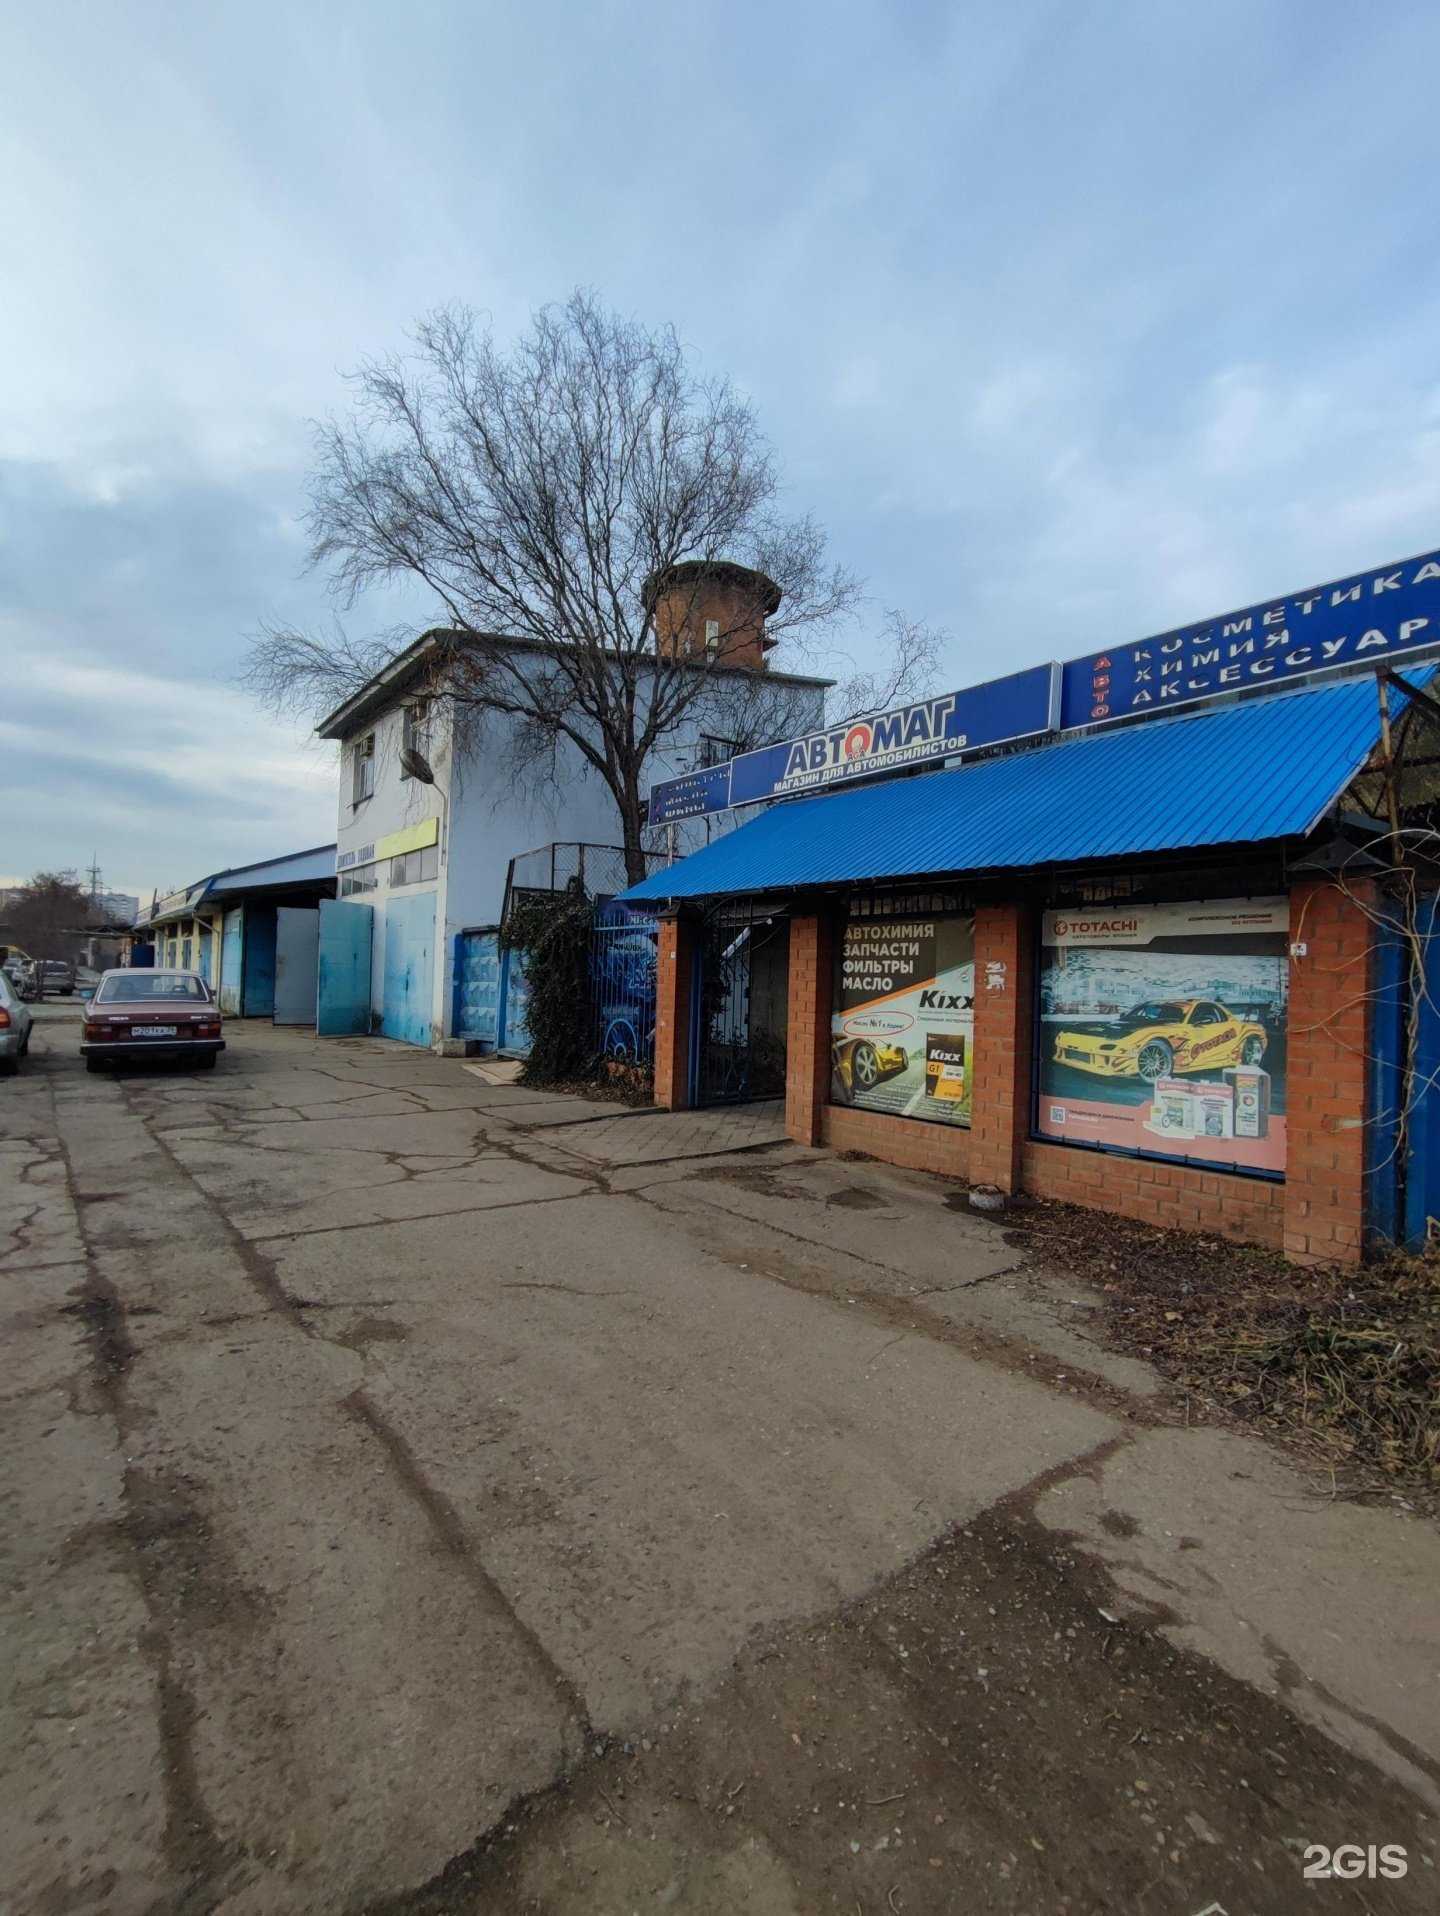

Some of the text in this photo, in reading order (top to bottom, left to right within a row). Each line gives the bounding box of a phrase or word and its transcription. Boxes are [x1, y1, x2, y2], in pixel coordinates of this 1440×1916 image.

[1134, 628, 1291, 683] ХИМИЯ
[1091, 655, 1112, 719] АВТО
[784, 695, 956, 780] АВТОМАГ
[774, 734, 968, 793] МАГАЗИН ДЛЯ АВТОМОБИЛИСТОВ
[844, 924, 935, 941] АВТОХИМИЯ
[1069, 919, 1138, 933] TOTACHI
[842, 942, 920, 957] ЗАПЧАСТИ
[842, 959, 914, 975] ФИЛЬТРЫ
[842, 976, 893, 991] МАСЛО
[919, 989, 975, 1010] Kixx
[930, 1049, 961, 1062] Kixx
